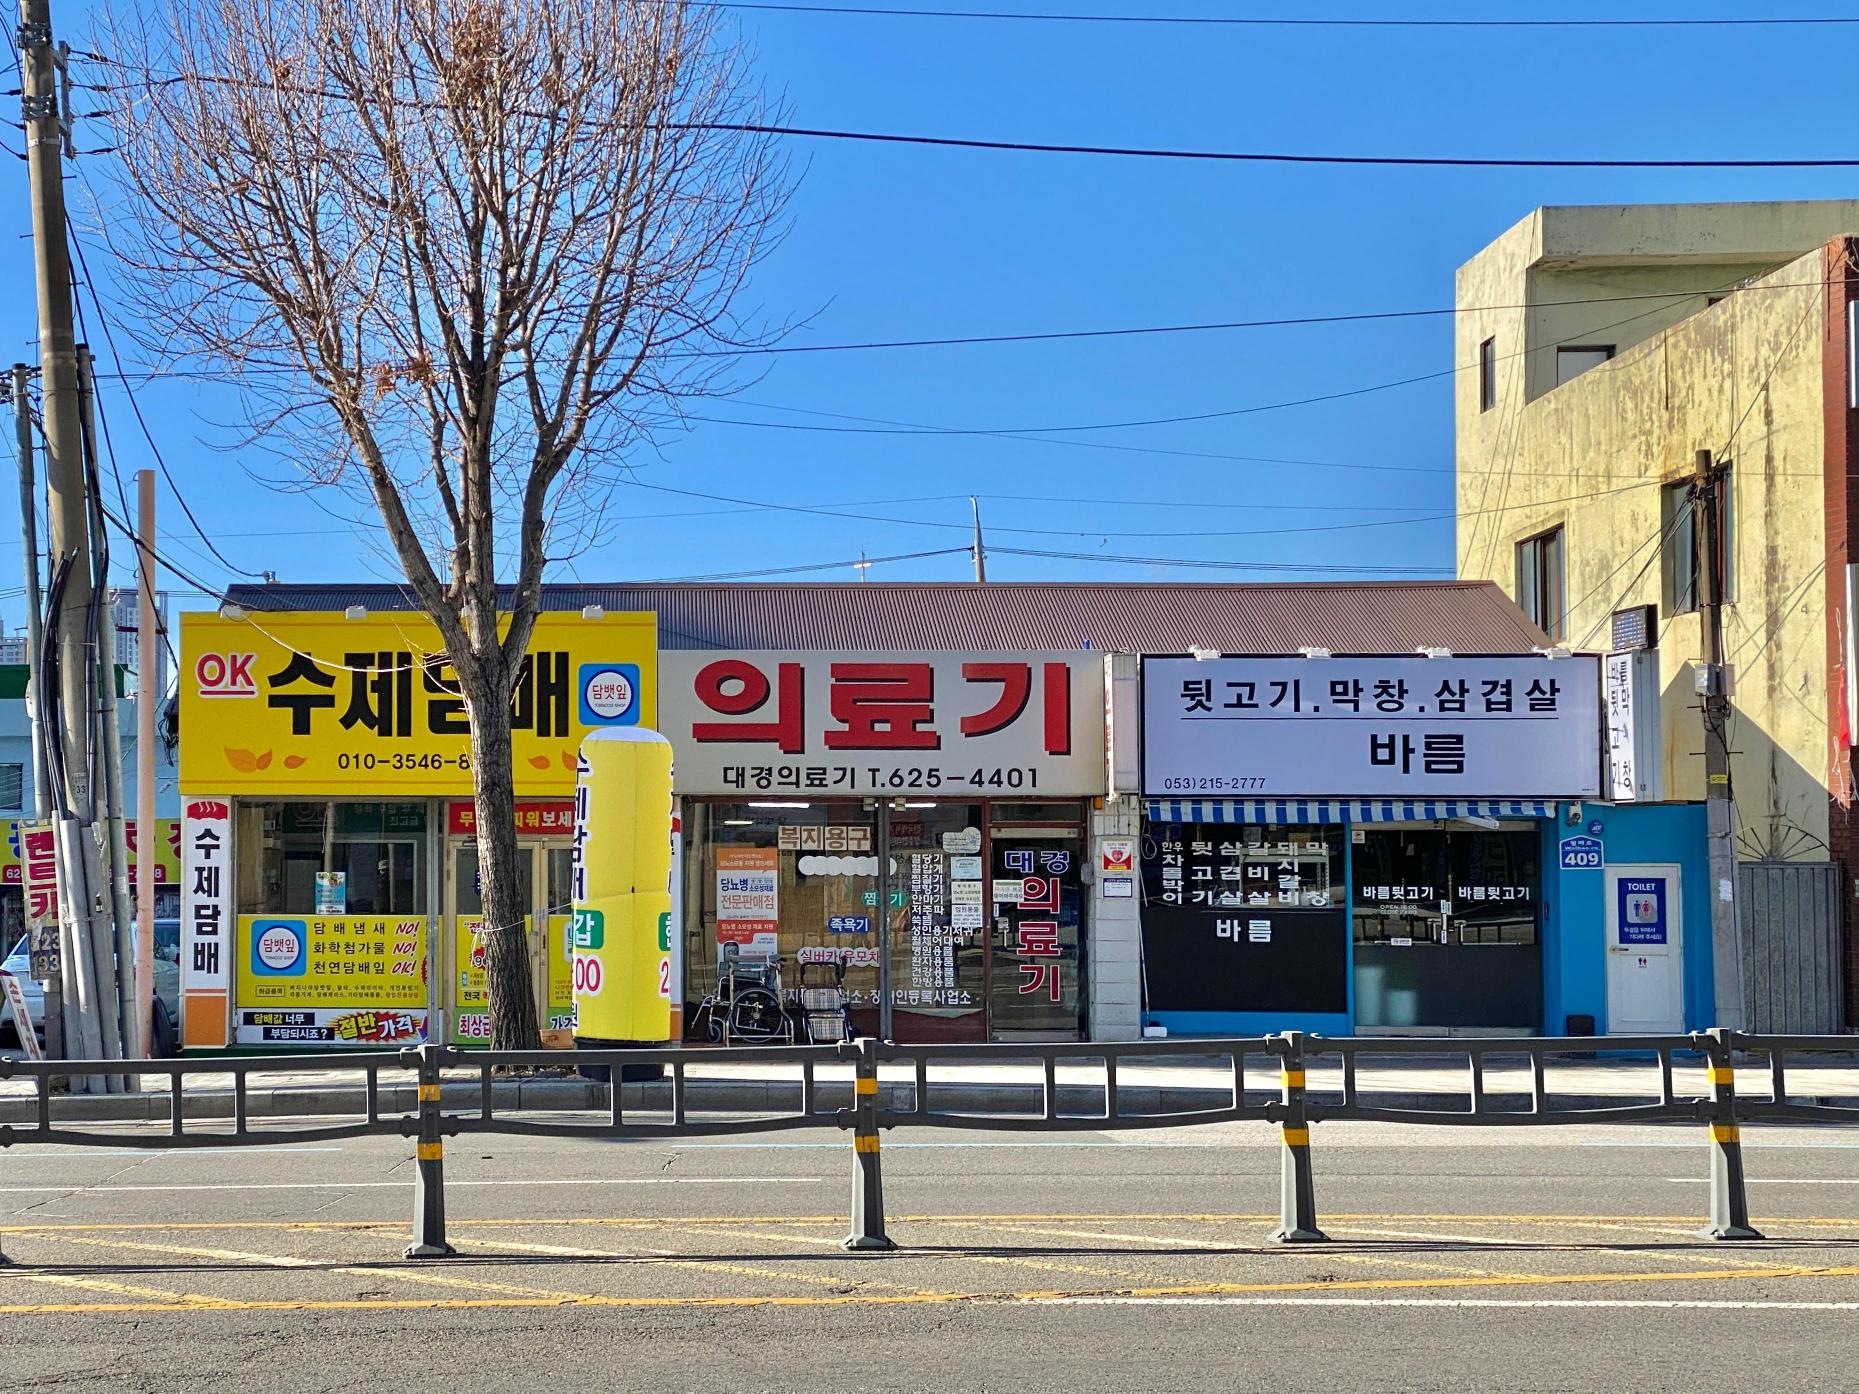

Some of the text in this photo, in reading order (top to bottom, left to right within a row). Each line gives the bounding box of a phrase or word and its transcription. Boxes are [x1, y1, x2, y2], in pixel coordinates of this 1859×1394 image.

[197, 653, 255, 687] OK
[592, 684, 627, 700] 담뱃잎
[692, 659, 1071, 755] 의료기
[1370, 733, 1466, 775] 바름
[722, 766, 1038, 789] 대경의료기 T.625-4401
[1164, 776, 1266, 790] 053)215-2777
[779, 826, 869, 849] 복지용구
[911, 853, 943, 864] 혈당기
[1004, 851, 1070, 874] 대경
[1564, 853, 1599, 866] 409
[911, 864, 943, 874] 혈압계
[1191, 841, 1213, 906] 뒷고기
[1219, 841, 1243, 906] 삼겹살
[1247, 841, 1272, 906] 갈비살
[1277, 841, 1302, 906] 돼지갈비
[1305, 841, 1329, 907] 막창
[720, 878, 749, 892] 당뇨병
[911, 874, 943, 884] 찜질기
[1162, 854, 1184, 905] 차돌박이
[1627, 883, 1656, 891] TOILET
[193, 828, 221, 974] 수제담배
[911, 894, 943, 905] 안마기
[1363, 886, 1434, 900] 바름뒷고기
[1458, 886, 1530, 901] 바름뒷고기
[721, 894, 775, 910] 전문판매점
[911, 905, 944, 916] 저주파
[395, 921, 420, 937] NO!
[830, 918, 869, 932] 족욕기
[1216, 919, 1272, 942] 바름
[31, 932, 60, 951] 23
[263, 938, 295, 953] 담뱃잎
[1017, 876, 1061, 1002] 의료기
[313, 941, 417, 957] 화학첨가물 NO!
[313, 961, 416, 977] 천연담배잎 OK!
[911, 956, 954, 967] 환자용품
[464, 991, 480, 1001] 전국
[253, 1014, 305, 1024] 담배값 너무
[339, 1013, 414, 1039] 절반 가격
